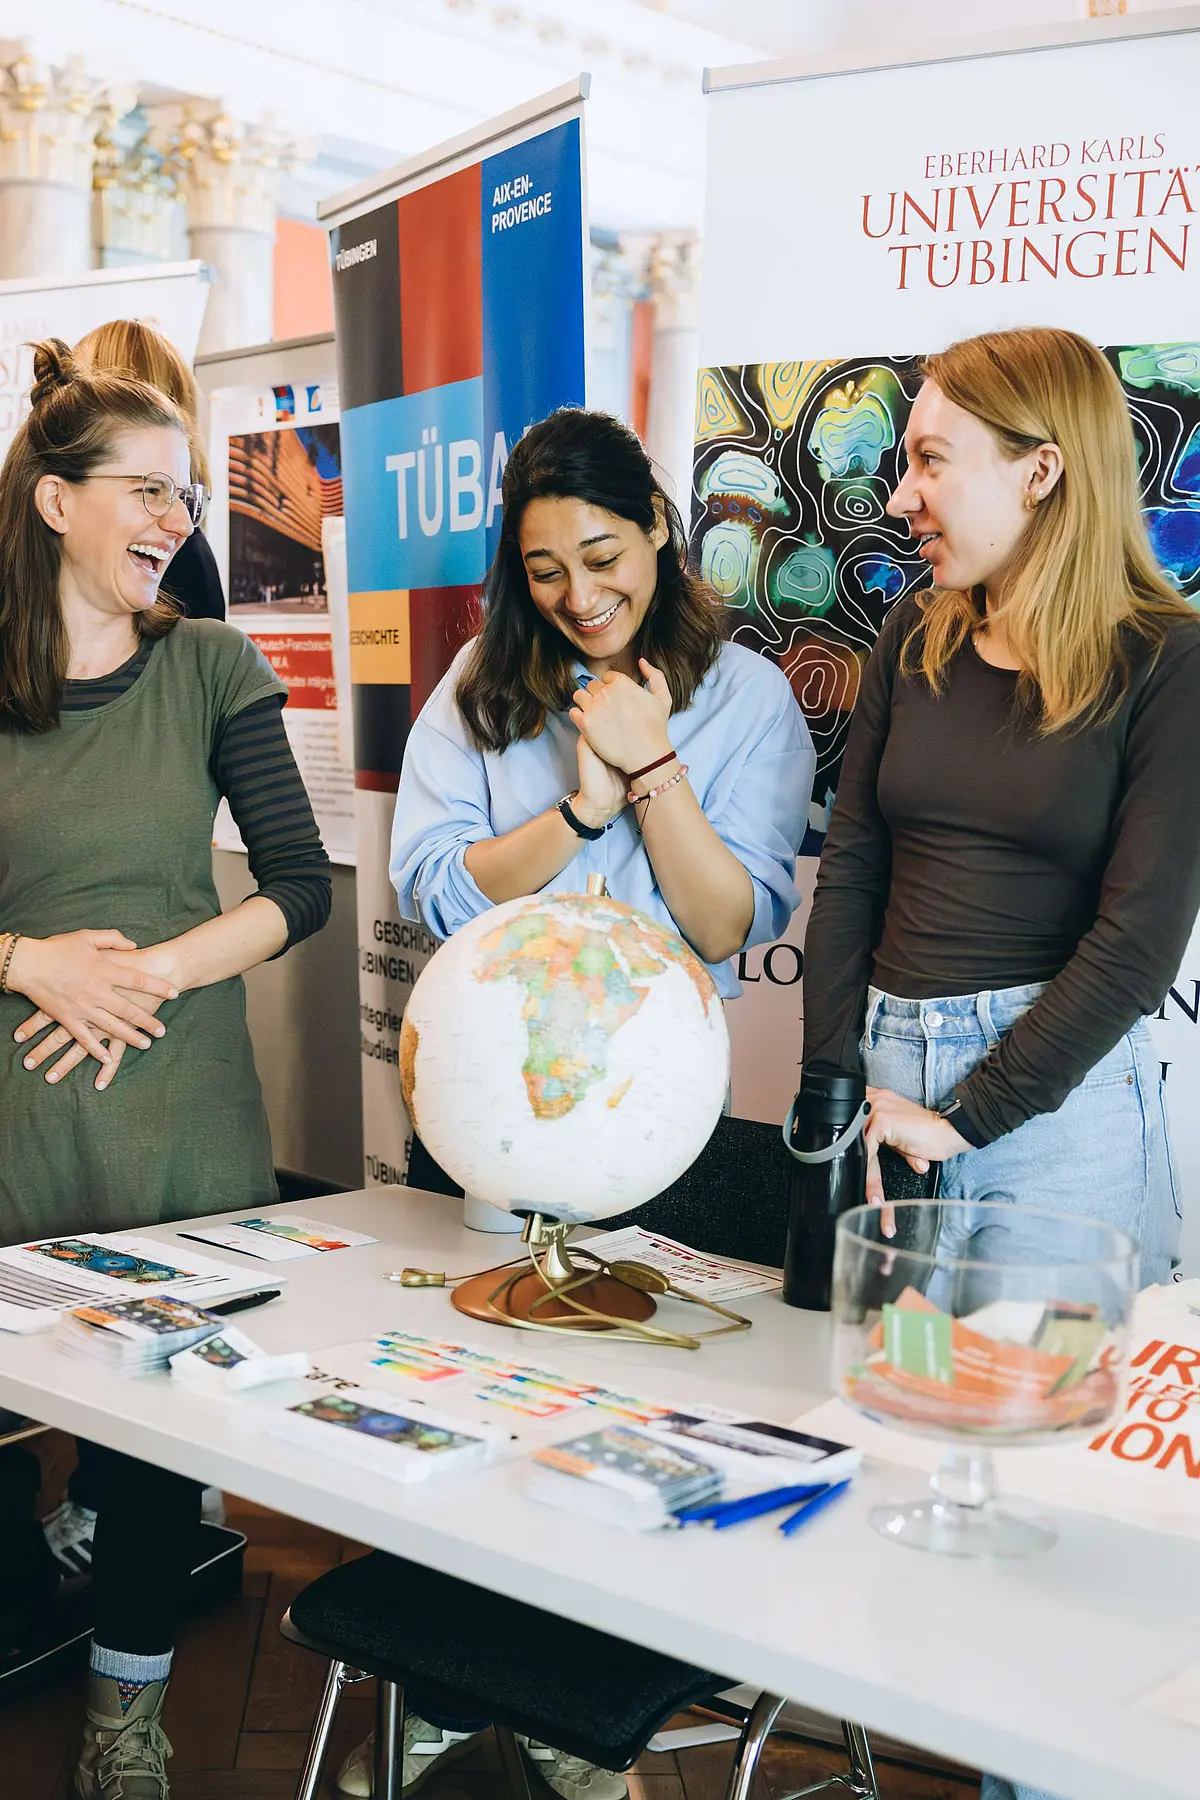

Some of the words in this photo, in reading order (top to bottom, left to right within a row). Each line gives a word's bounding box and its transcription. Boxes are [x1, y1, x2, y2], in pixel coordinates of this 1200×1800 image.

[924, 143, 1071, 179] EBERHARD
[1081, 133, 1166, 164] KARLS
[493, 175, 534, 207] AIX-EN-
[861, 165, 1200, 239] UNIVERSITÄ
[492, 192, 552, 234] PROVENCE
[336, 239, 377, 272] TÜBINGEN
[887, 224, 1192, 290] TÜBINGEN
[385, 426, 531, 539] TÜBA
[374, 920, 440, 955] GESCHICH
[361, 944, 415, 985] BINGEN
